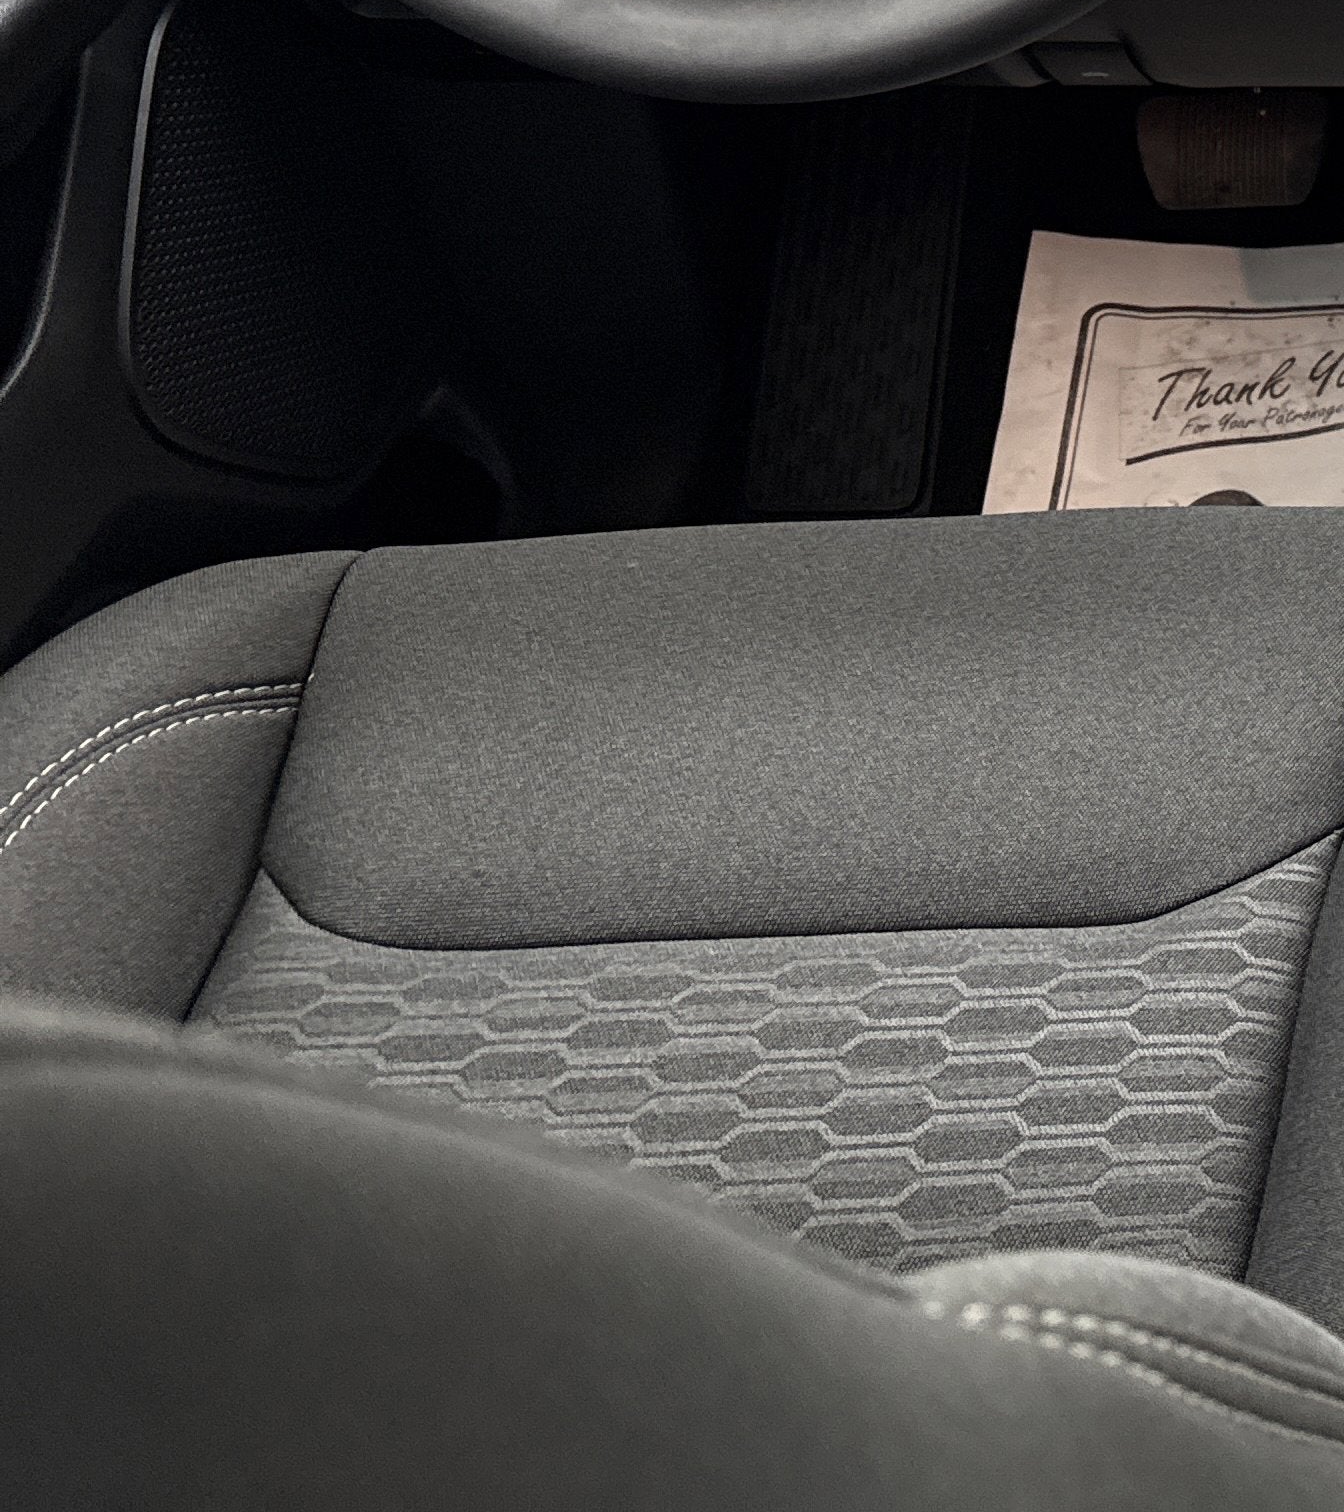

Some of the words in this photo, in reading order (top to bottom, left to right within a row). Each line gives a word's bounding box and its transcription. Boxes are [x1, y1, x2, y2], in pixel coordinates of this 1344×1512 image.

[1152, 356, 1297, 422] Thank
[1180, 417, 1211, 437] For
[1218, 412, 1255, 433] Your
[1263, 402, 1344, 427] Patronage
